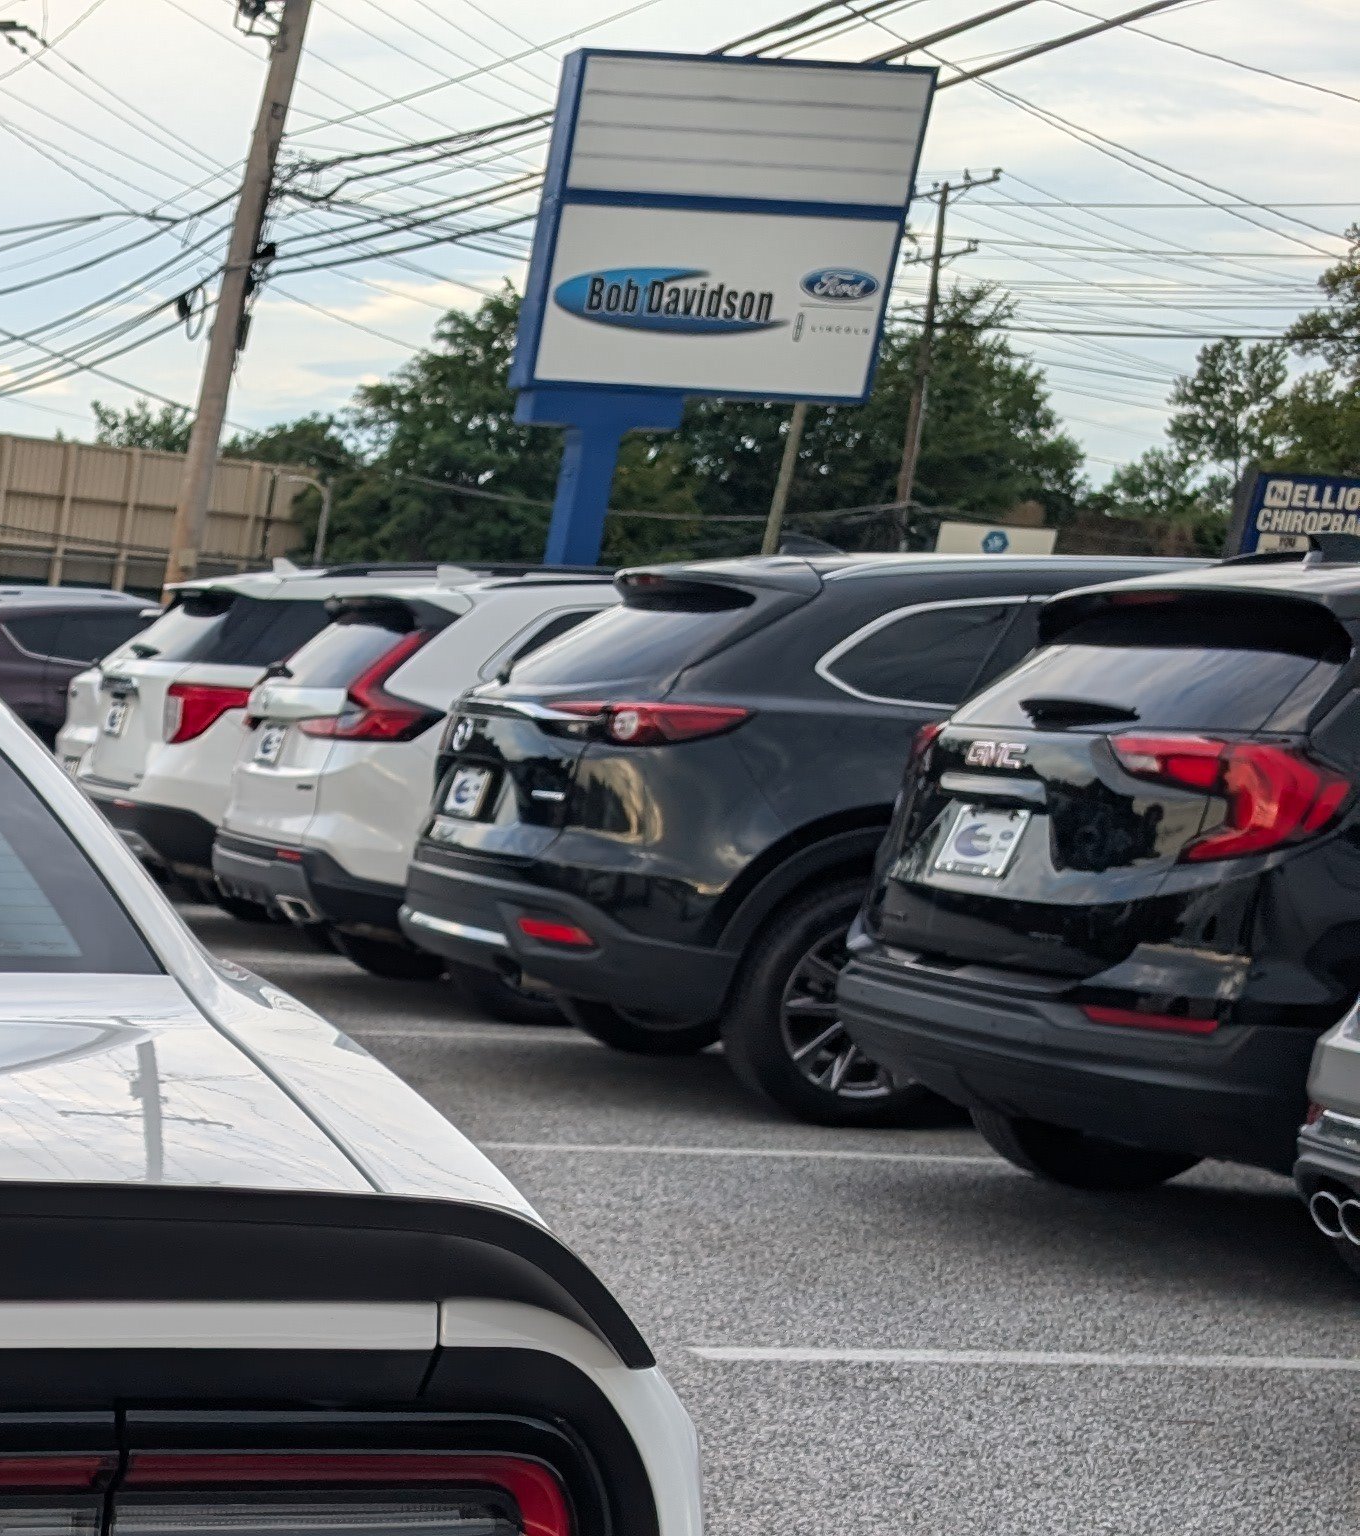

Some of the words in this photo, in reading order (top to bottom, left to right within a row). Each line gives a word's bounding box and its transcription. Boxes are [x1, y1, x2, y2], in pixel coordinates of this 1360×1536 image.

[813, 271, 869, 298] Ford
[587, 277, 638, 314] Bob
[646, 278, 776, 322] Davidson
[1256, 508, 1360, 536] CHIROPRA
[965, 740, 1028, 769] GMC
